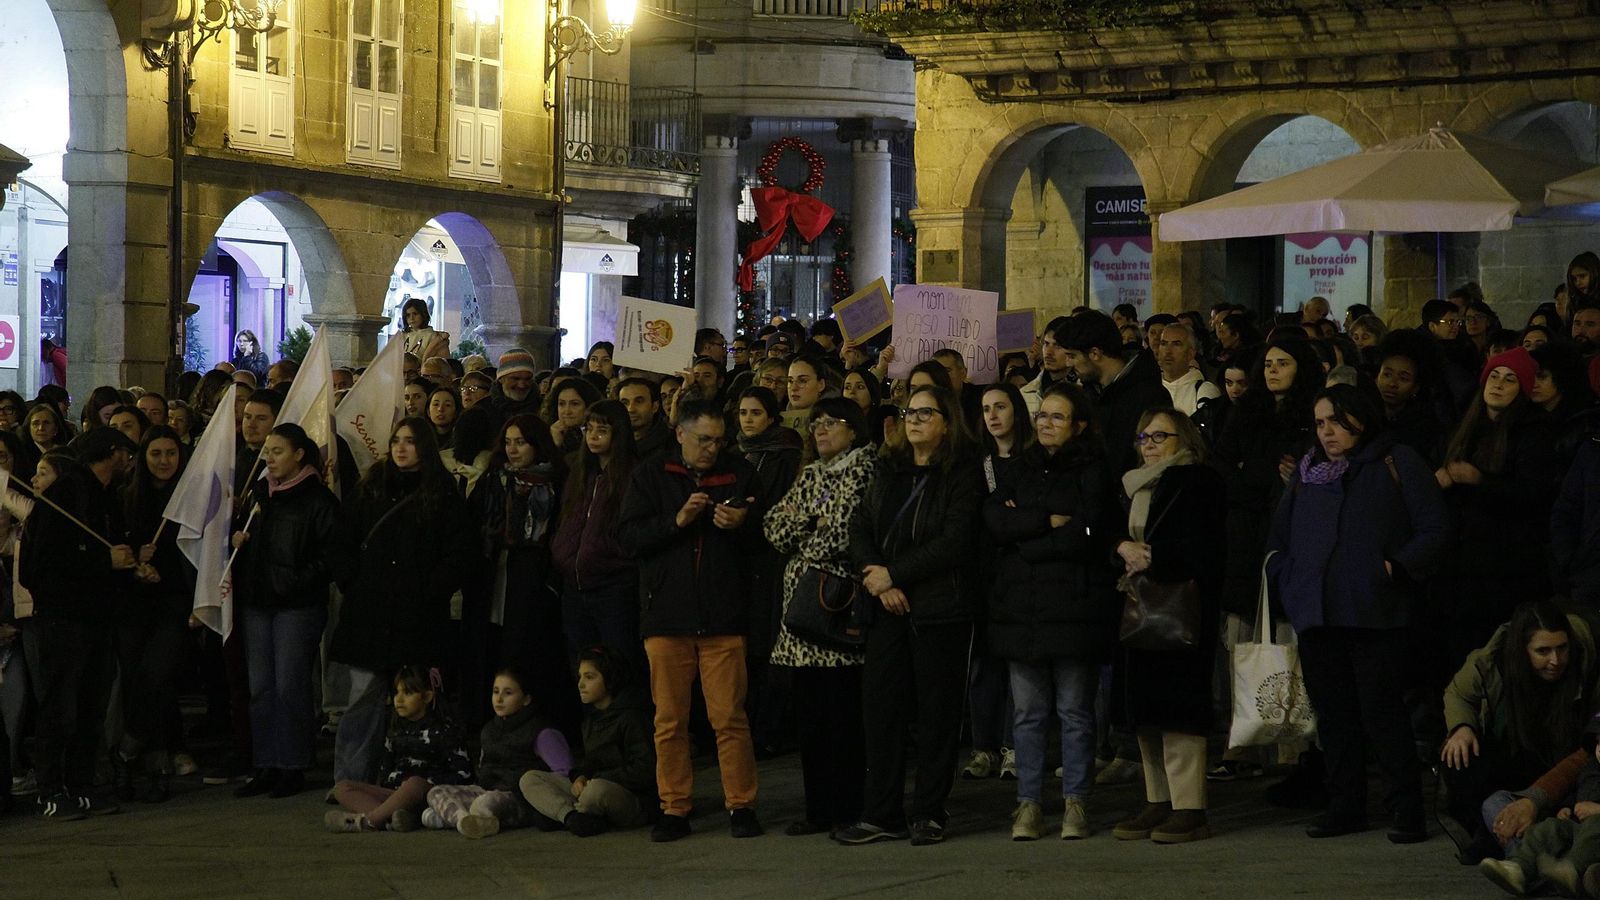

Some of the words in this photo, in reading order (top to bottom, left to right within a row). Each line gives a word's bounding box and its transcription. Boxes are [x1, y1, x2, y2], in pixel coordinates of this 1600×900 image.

[1295, 253, 1357, 265] Elaboración
[1093, 260, 1137, 270] Descubre
[1140, 261, 1150, 270] tu
[1105, 271, 1125, 280] más
[1309, 265, 1344, 278] propia
[1119, 287, 1146, 297] Praza
